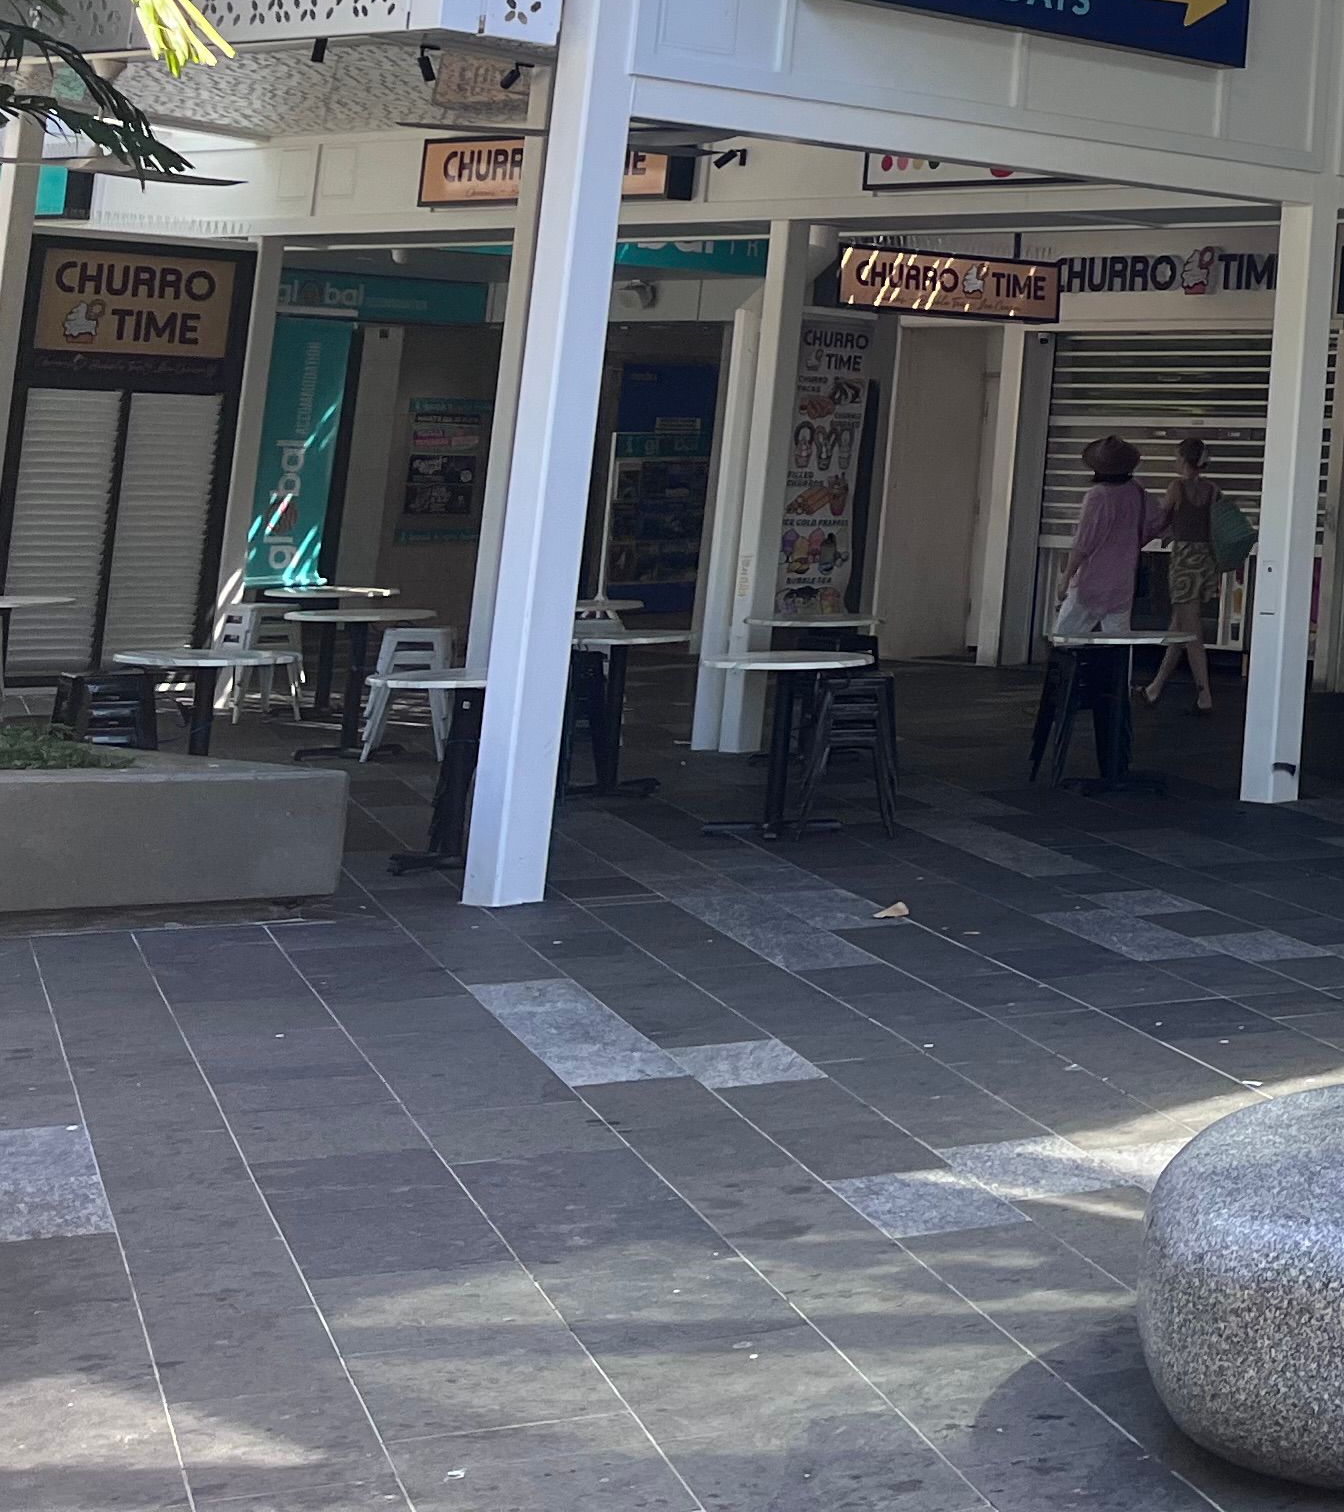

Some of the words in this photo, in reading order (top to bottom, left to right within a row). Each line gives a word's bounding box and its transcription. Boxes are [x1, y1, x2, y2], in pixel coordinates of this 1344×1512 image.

[443, 148, 523, 183] CHURR
[55, 261, 217, 301] CHURRO
[855, 259, 960, 293] CHURRO
[992, 272, 1047, 301] TIME
[1219, 254, 1277, 289] TIM
[111, 308, 202, 345] TIME
[803, 330, 869, 350] CHURRO
[826, 354, 862, 372] TIME
